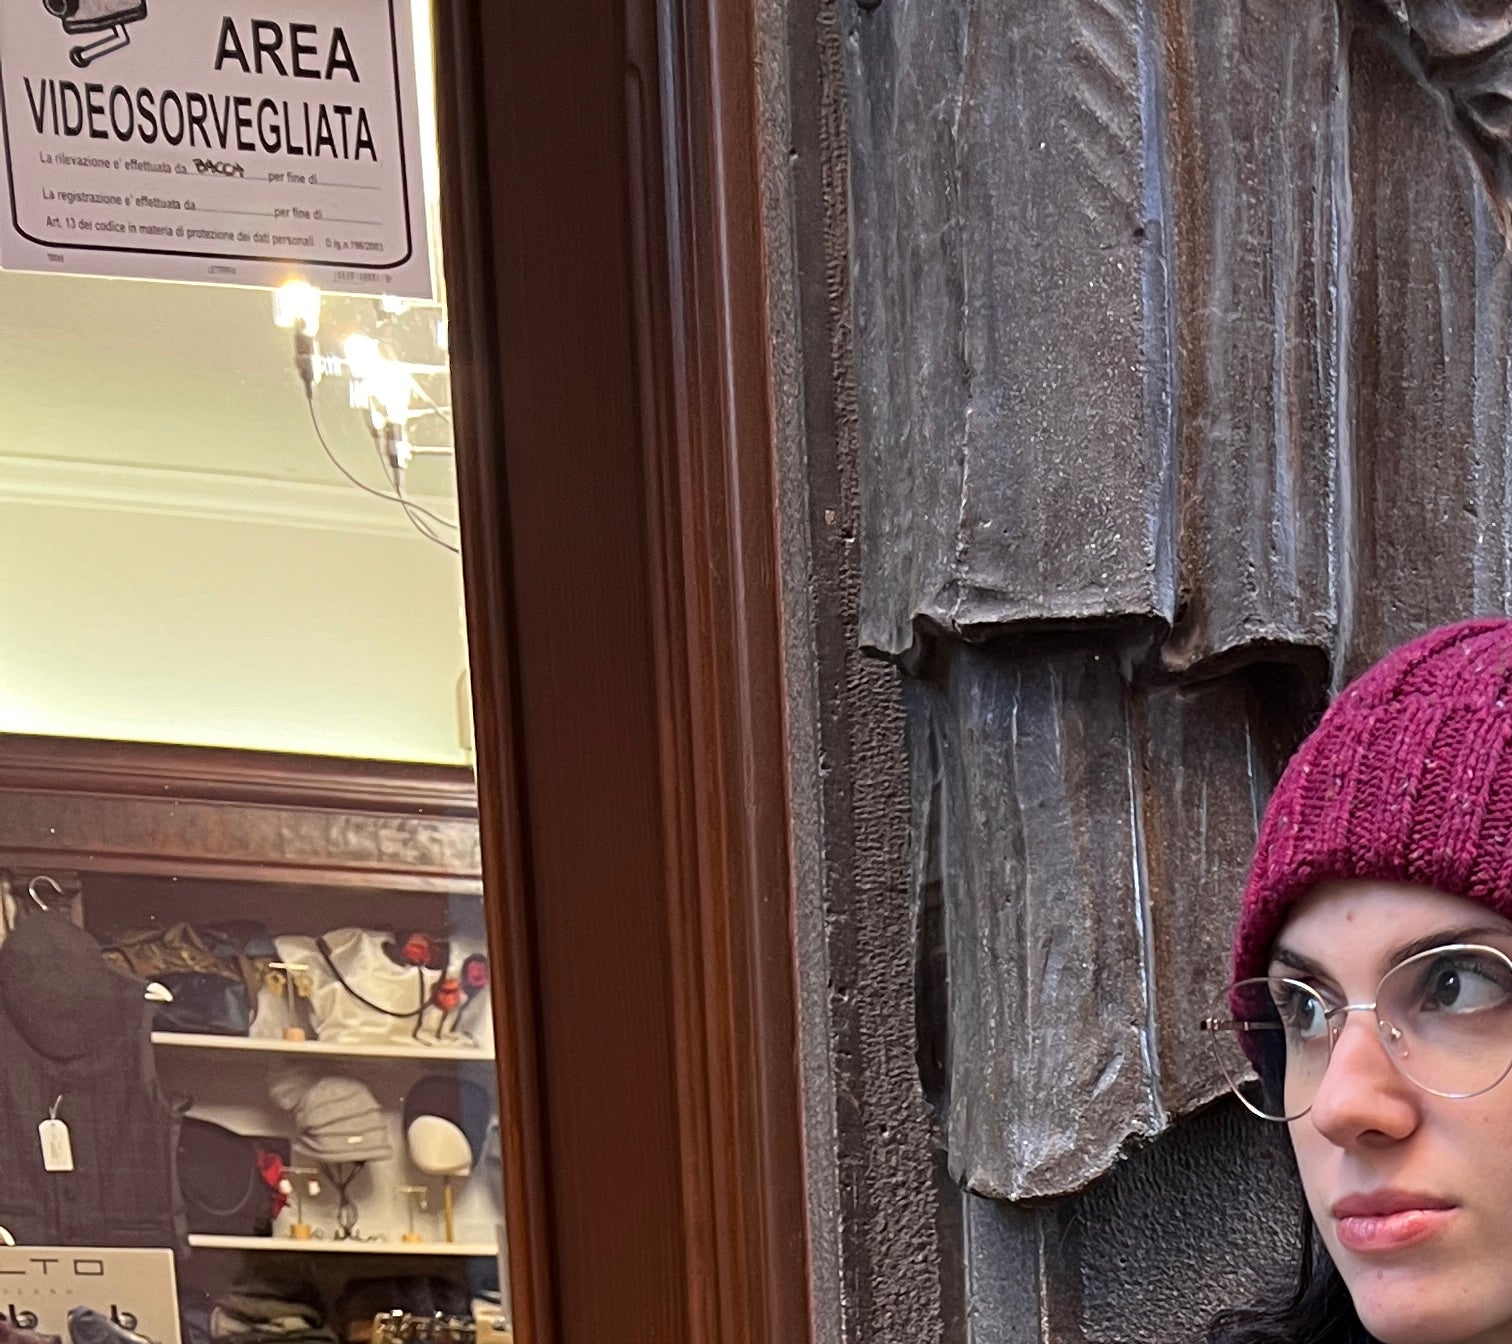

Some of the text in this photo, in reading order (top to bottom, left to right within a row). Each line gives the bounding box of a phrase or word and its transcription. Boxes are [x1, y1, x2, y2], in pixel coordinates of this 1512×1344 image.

[214, 15, 361, 83] AREA
[23, 76, 378, 162] VIDEOSORVEGLIATA
[39, 151, 53, 164] La
[55, 153, 110, 169] rilevazione
[124, 158, 171, 174] effettuata
[174, 163, 187, 174] da
[268, 172, 284, 183] per
[286, 172, 305, 184] fine
[308, 174, 318, 185] di
[42, 187, 55, 200] La
[57, 190, 122, 206] registrazione
[135, 195, 181, 210] effettuata
[184, 200, 196, 211] da
[274, 208, 290, 219] per
[292, 207, 311, 220] fine
[313, 209, 322, 220] di
[65, 217, 76, 229] 13
[95, 220, 126, 233] codice
[128, 221, 137, 234] in
[139, 225, 173, 237] materia
[175, 225, 184, 238] di
[186, 229, 235, 242] protezione
[253, 232, 270, 244] dati
[272, 234, 314, 247] personali
